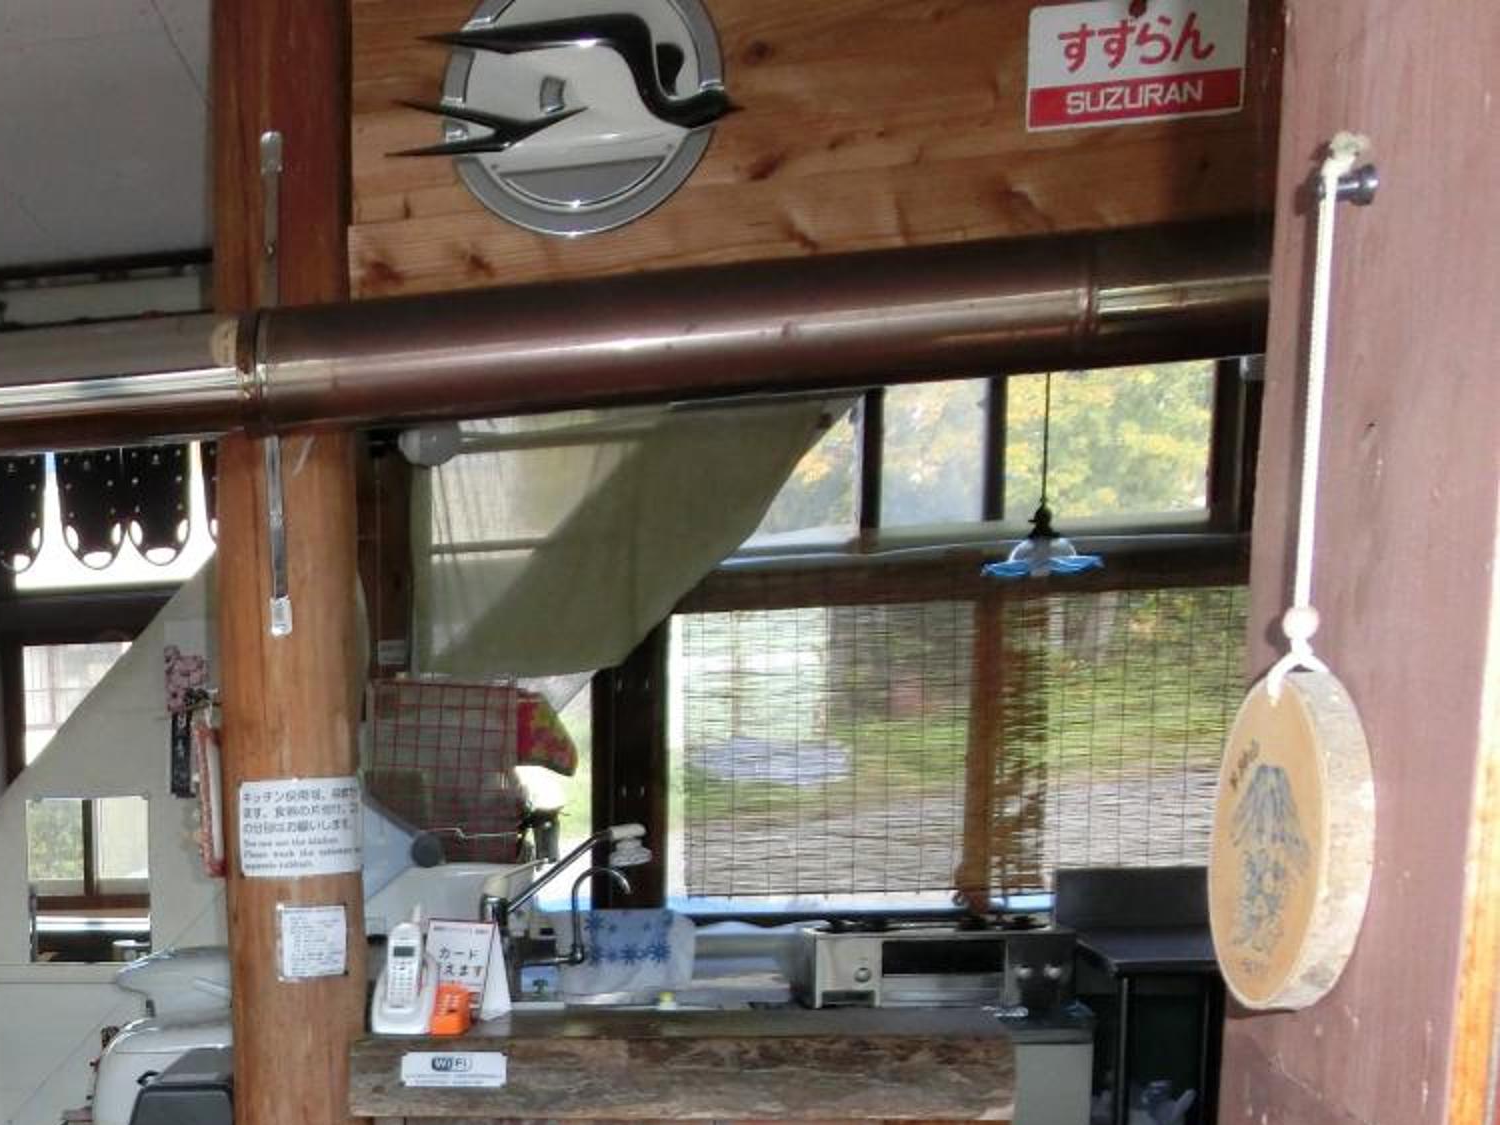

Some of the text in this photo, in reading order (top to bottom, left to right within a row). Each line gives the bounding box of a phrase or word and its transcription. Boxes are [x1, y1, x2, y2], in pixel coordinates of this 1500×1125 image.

[1066, 79, 1205, 115] SUZURAN
[438, 946, 482, 960] カード
[436, 962, 484, 977] えます
